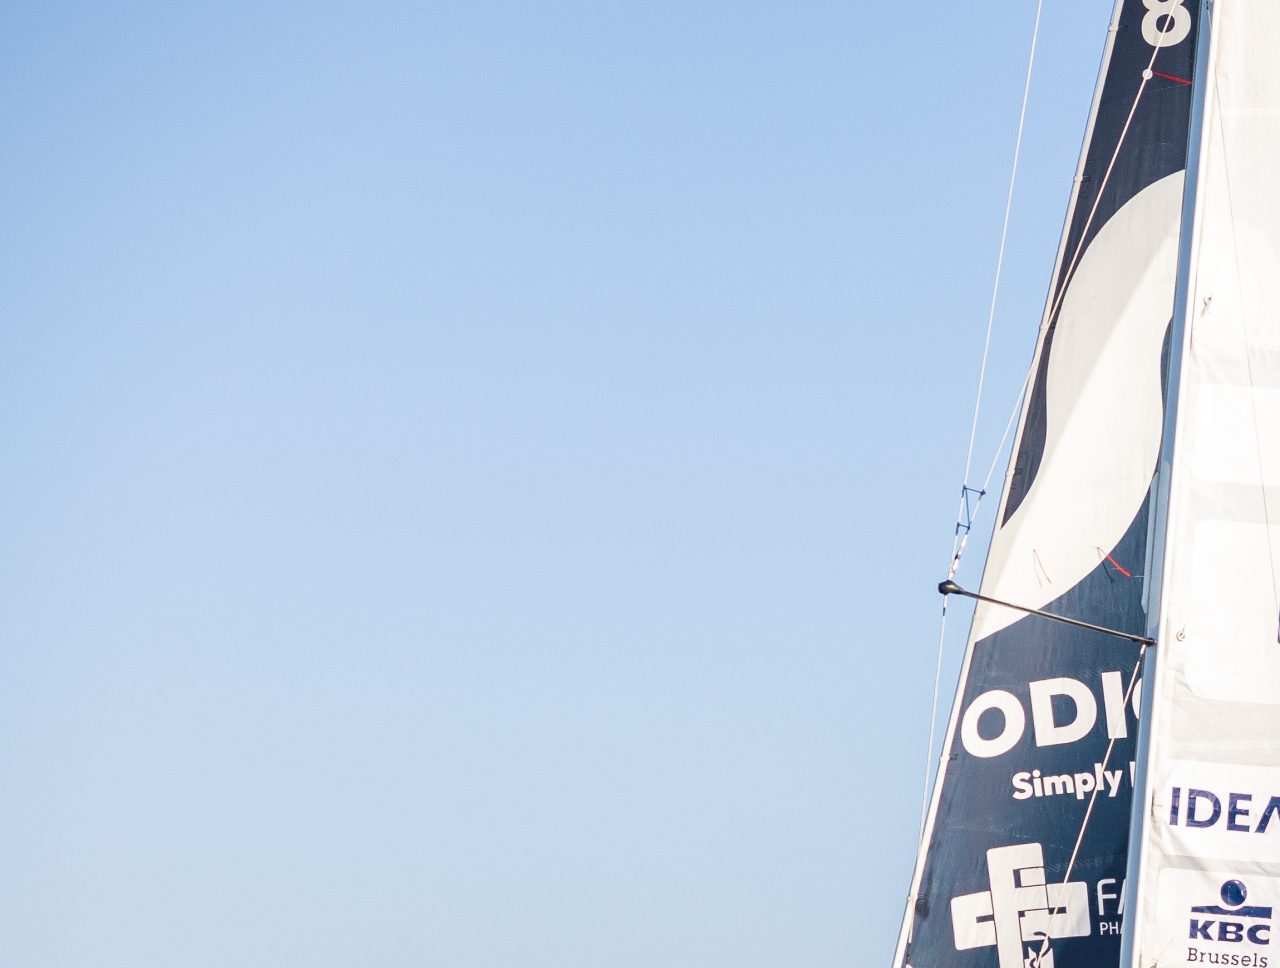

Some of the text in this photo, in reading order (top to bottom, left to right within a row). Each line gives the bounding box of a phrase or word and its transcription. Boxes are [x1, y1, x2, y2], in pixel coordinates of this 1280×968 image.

[961, 671, 1143, 758] ODI
[1012, 763, 1123, 800] Simply
[1188, 919, 1271, 945] KBC
[1186, 947, 1268, 968] Brussels
